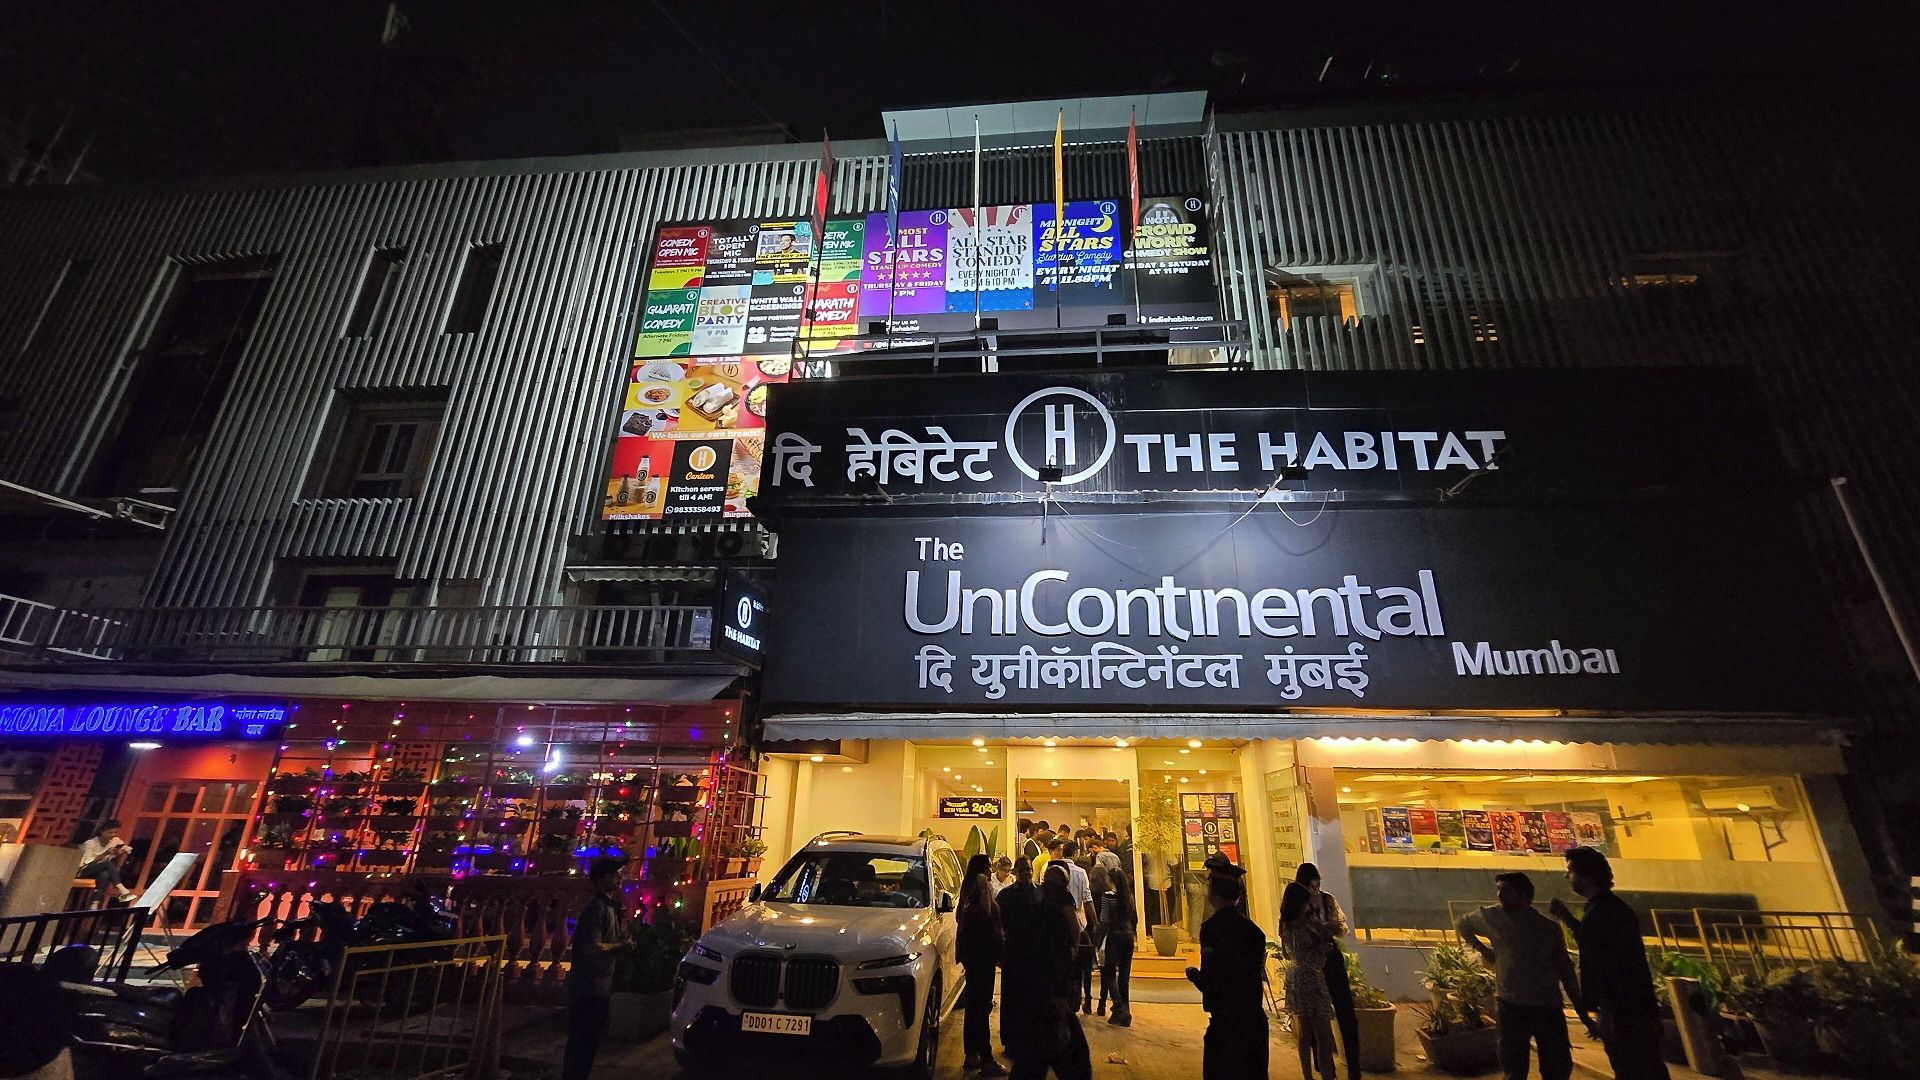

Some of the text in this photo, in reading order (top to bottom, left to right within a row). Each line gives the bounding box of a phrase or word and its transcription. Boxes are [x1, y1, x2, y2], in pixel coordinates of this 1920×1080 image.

[1169, 216, 1178, 224] A
[1040, 226, 1080, 240] ALL
[1135, 224, 1197, 237] CROWD
[660, 239, 696, 248] COMEDY
[713, 234, 755, 245] TOTALLY
[840, 240, 855, 248] MIC
[885, 235, 928, 248] ALL
[987, 234, 1027, 246] STAR
[1039, 237, 1114, 252] STARS
[718, 242, 745, 251] OPEN
[953, 245, 1027, 258] STANDUP
[1173, 247, 1207, 256] SHOW
[659, 248, 699, 257] OPEN MIC
[723, 250, 741, 258] MIC
[867, 248, 944, 265] STARS
[1076, 251, 1113, 261] Comedy
[955, 255, 1024, 268] COMEDY
[986, 269, 1009, 277] NIGHT
[1011, 268, 1020, 277] AT
[1078, 265, 1120, 274] NIGHT
[1003, 277, 1015, 285] PM
[700, 298, 747, 306] CREATIVE
[750, 295, 804, 304] WHITE WALL
[647, 303, 695, 315] GUJARATI
[699, 305, 745, 316] BLOC
[749, 302, 803, 311] SCREENINGS
[696, 315, 744, 326] PARTY
[815, 310, 852, 322] OMEDY
[643, 319, 685, 329] COMEDY
[667, 431, 688, 439] bake
[772, 426, 998, 487] दि हेबिटेट
[1124, 431, 1506, 473] THE HABITAT
[685, 472, 715, 480] Canteen
[914, 538, 964, 561] The
[904, 569, 1445, 641] UniContinental
[724, 625, 738, 641] THE
[1451, 640, 1620, 676] Mumbai
[915, 644, 957, 694] दि
[1265, 642, 1369, 700] मुंबई
[0, 706, 225, 732] MONA LOUNGE BAR
[972, 802, 999, 815] 2025
[749, 1016, 772, 1029] DD01
[785, 1018, 809, 1032] 7291
